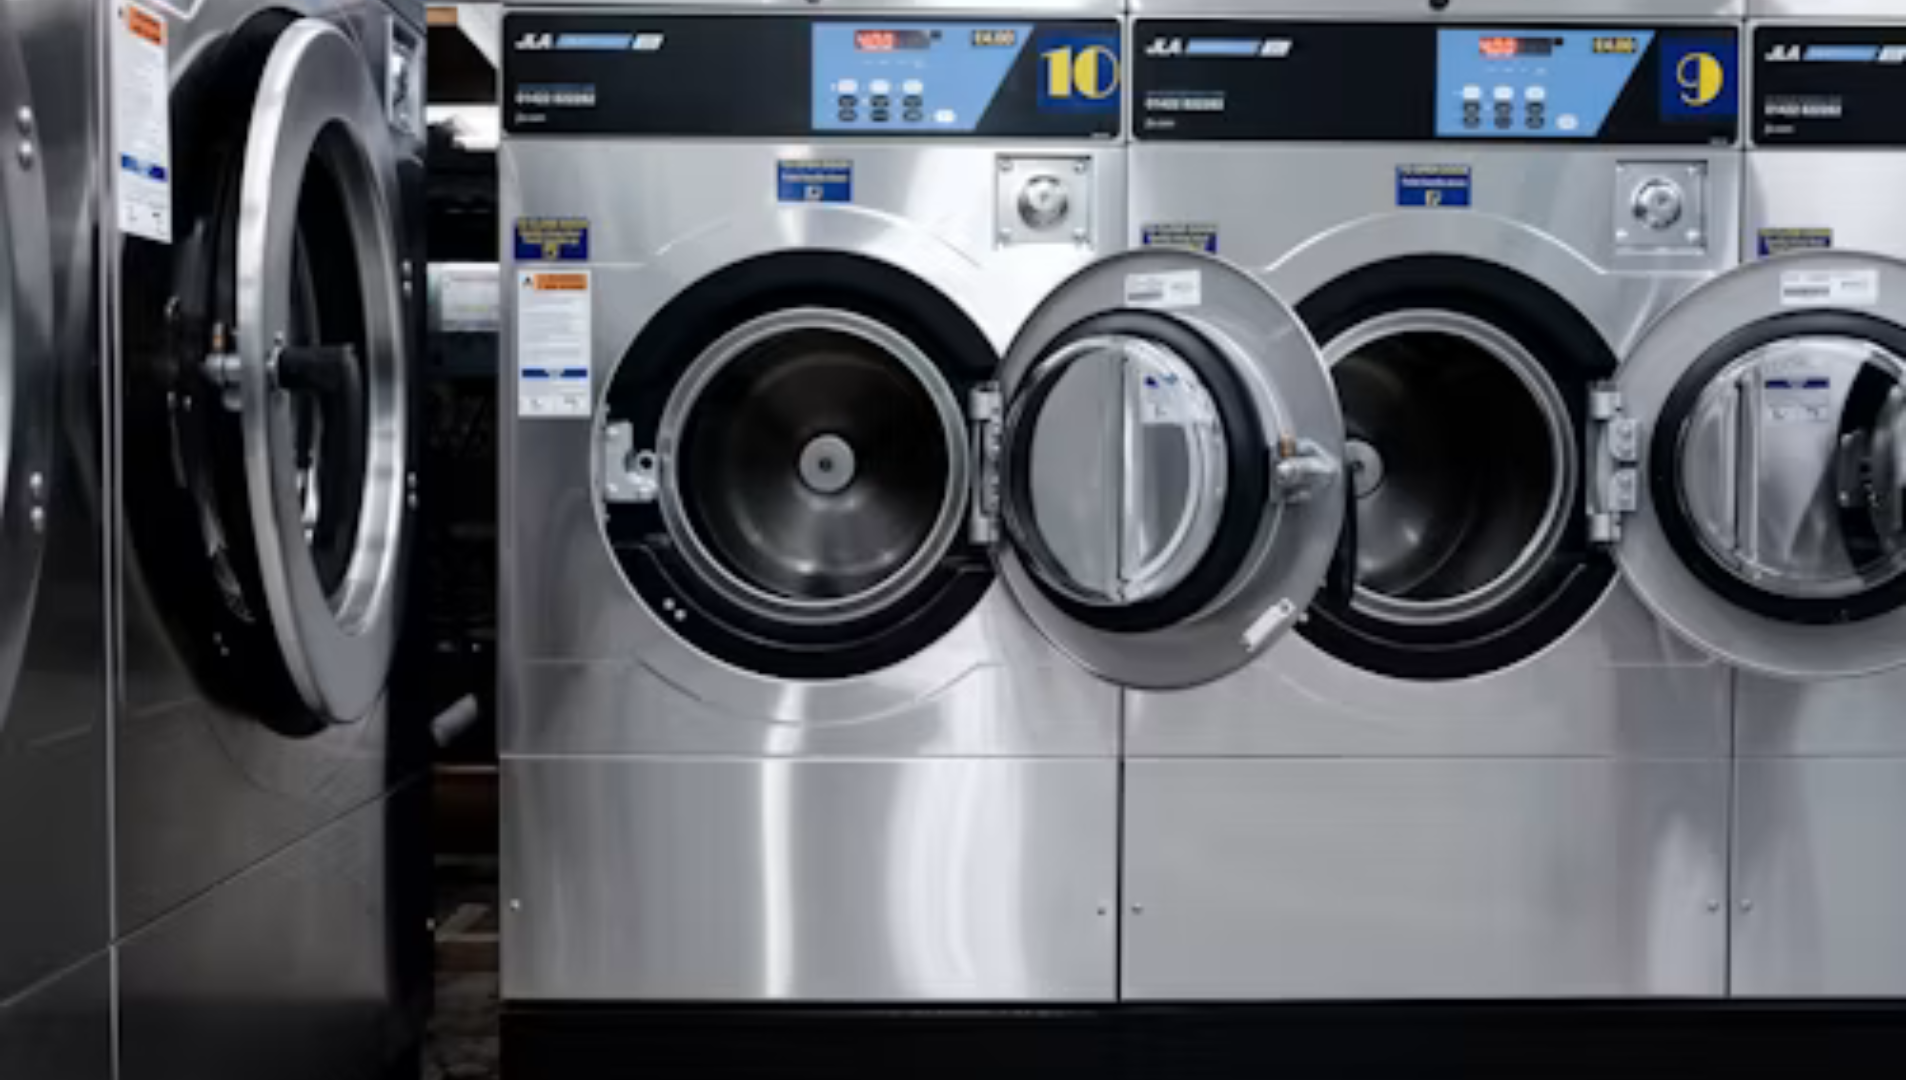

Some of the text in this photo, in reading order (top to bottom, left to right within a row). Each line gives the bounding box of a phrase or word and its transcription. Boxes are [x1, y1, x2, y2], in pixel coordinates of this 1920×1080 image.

[515, 33, 553, 50] JLA
[1144, 38, 1182, 56] JLA
[1764, 44, 1801, 62] JLA
[1041, 46, 1121, 99] 10
[1676, 52, 1725, 107] 9
